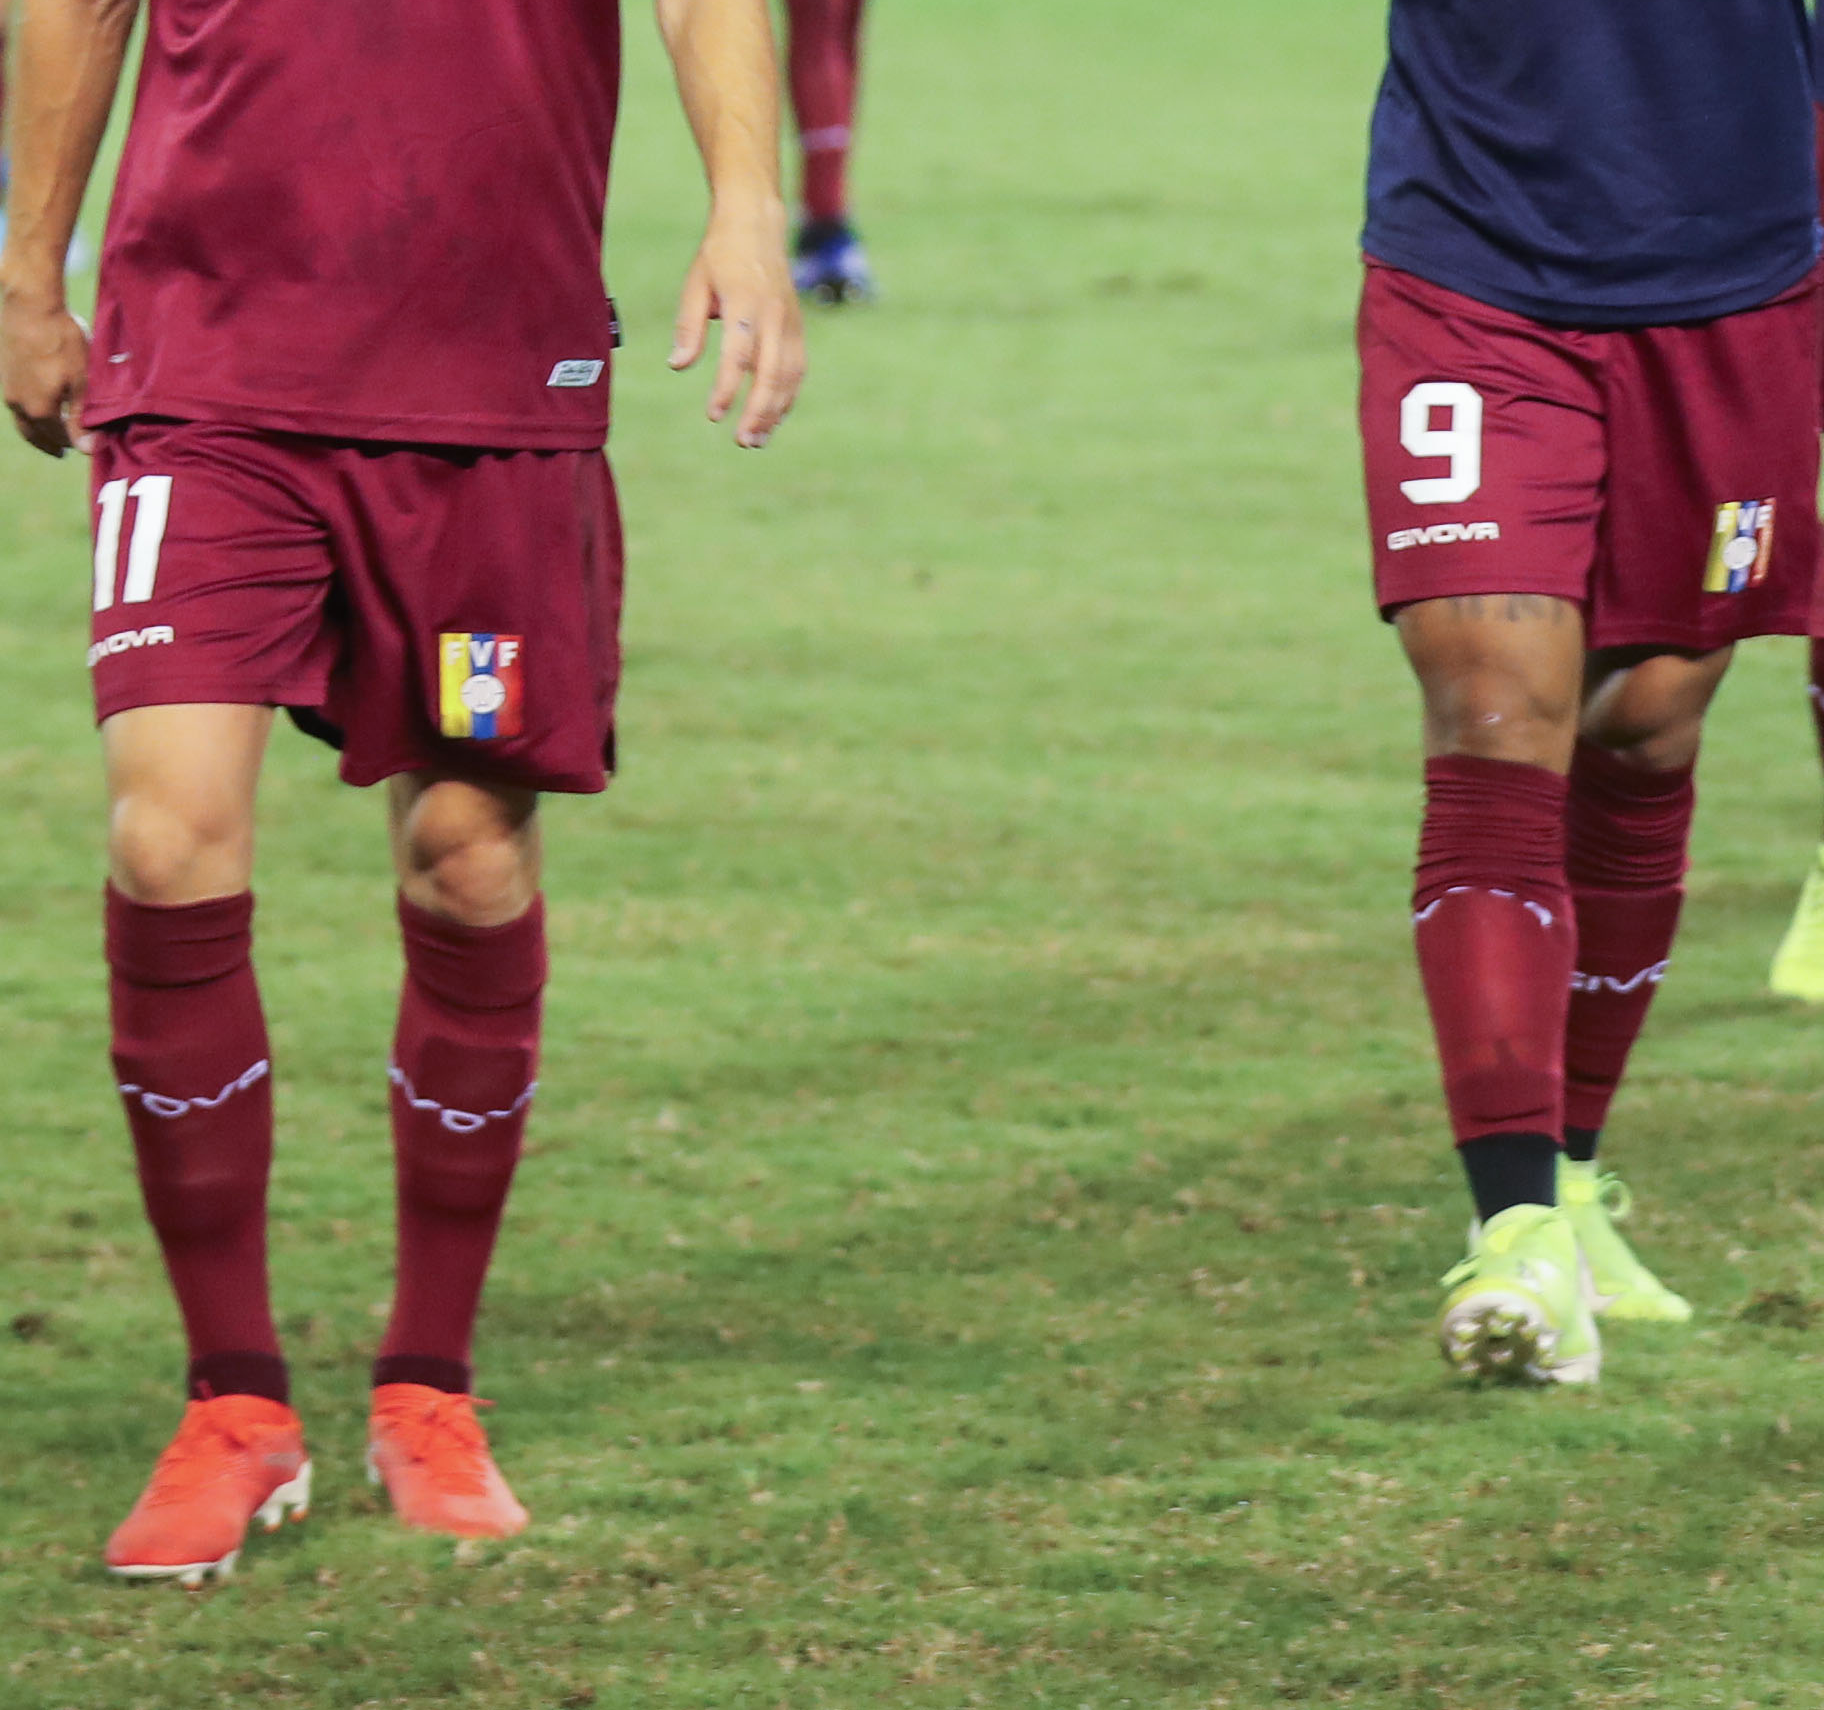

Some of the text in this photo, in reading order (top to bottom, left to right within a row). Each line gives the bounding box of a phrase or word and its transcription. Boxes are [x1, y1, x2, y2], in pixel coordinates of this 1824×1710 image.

[1399, 382, 1484, 505] 9
[93, 474, 173, 613] 11
[1387, 522, 1501, 552] GIVOVA
[444, 641, 520, 669] FVF
